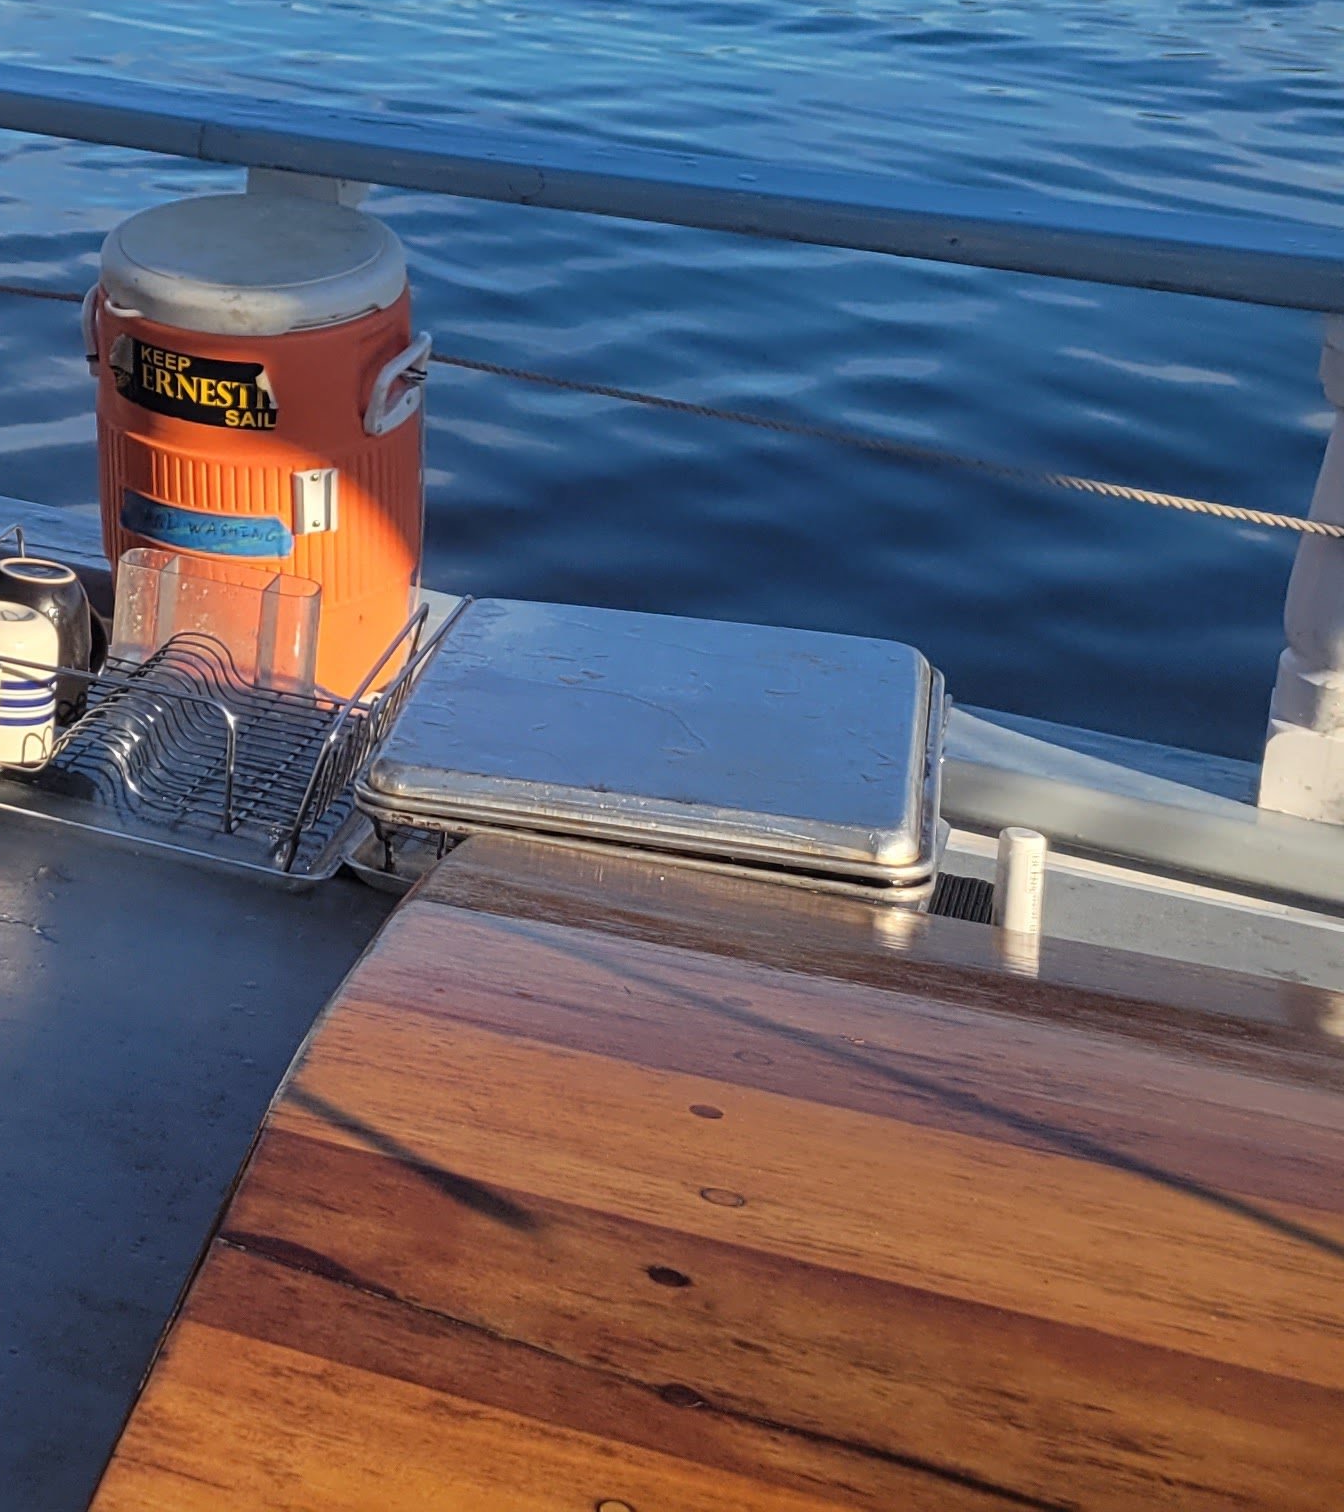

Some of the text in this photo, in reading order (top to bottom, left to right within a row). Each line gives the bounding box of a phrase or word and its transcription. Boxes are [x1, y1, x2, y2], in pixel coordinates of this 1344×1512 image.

[140, 345, 192, 372] KEEP
[225, 410, 277, 428] SAIL
[188, 520, 278, 543] WASHING
